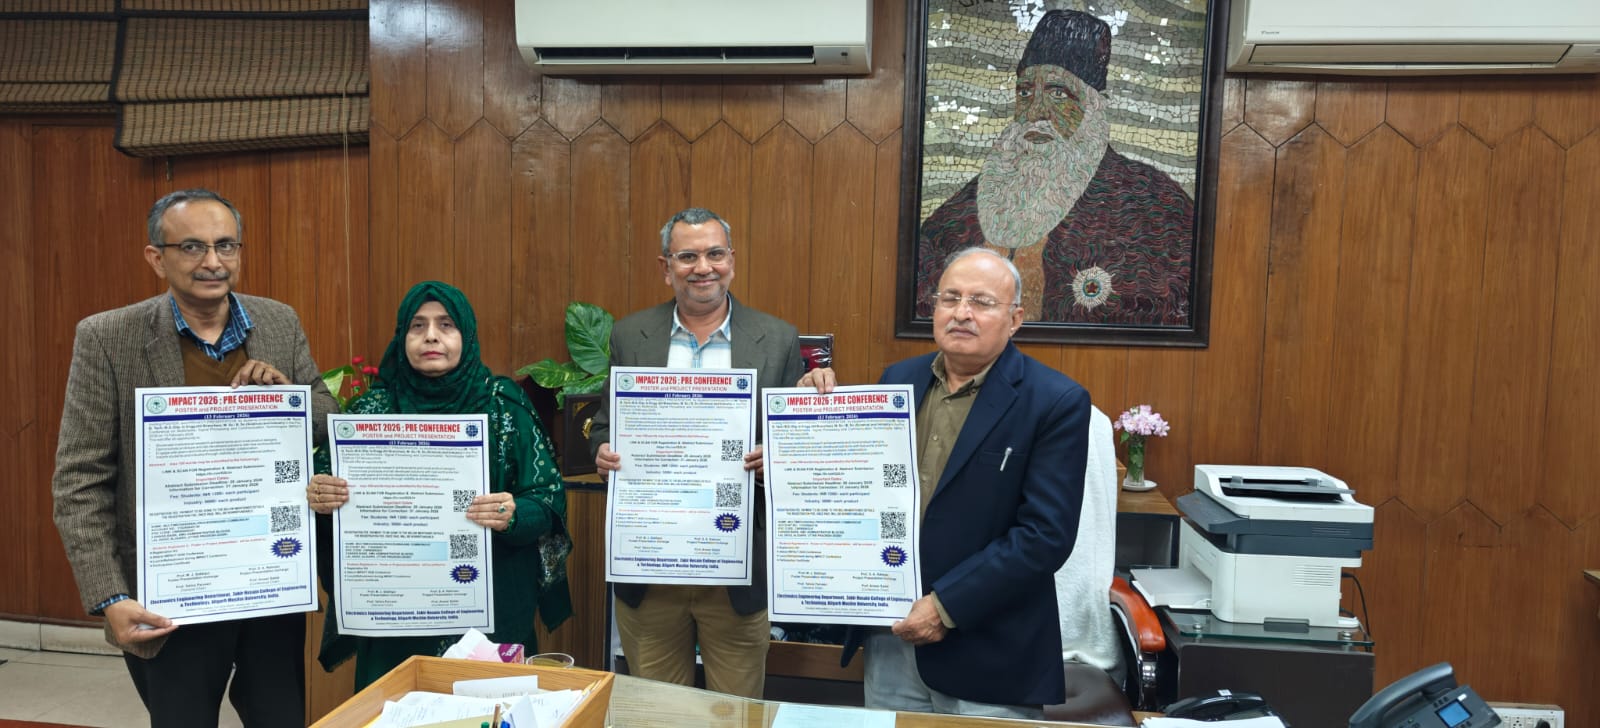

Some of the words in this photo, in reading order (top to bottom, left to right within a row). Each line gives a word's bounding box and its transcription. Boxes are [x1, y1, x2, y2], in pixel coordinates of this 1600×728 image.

[636, 376, 659, 384] IMPACT
[681, 376, 692, 384] PRE
[694, 377, 732, 385] CONFERENCE
[169, 396, 197, 406] IMPACT
[199, 396, 218, 405] 2026
[223, 395, 237, 404] PRE
[238, 394, 283, 403] CONFERENCE
[787, 397, 811, 405] IMPACT
[833, 396, 846, 405] PRE
[847, 394, 888, 404] CONFERENCE
[383, 423, 401, 432] 2026
[405, 424, 417, 432] PRE
[419, 424, 460, 432] CONFERENCE
